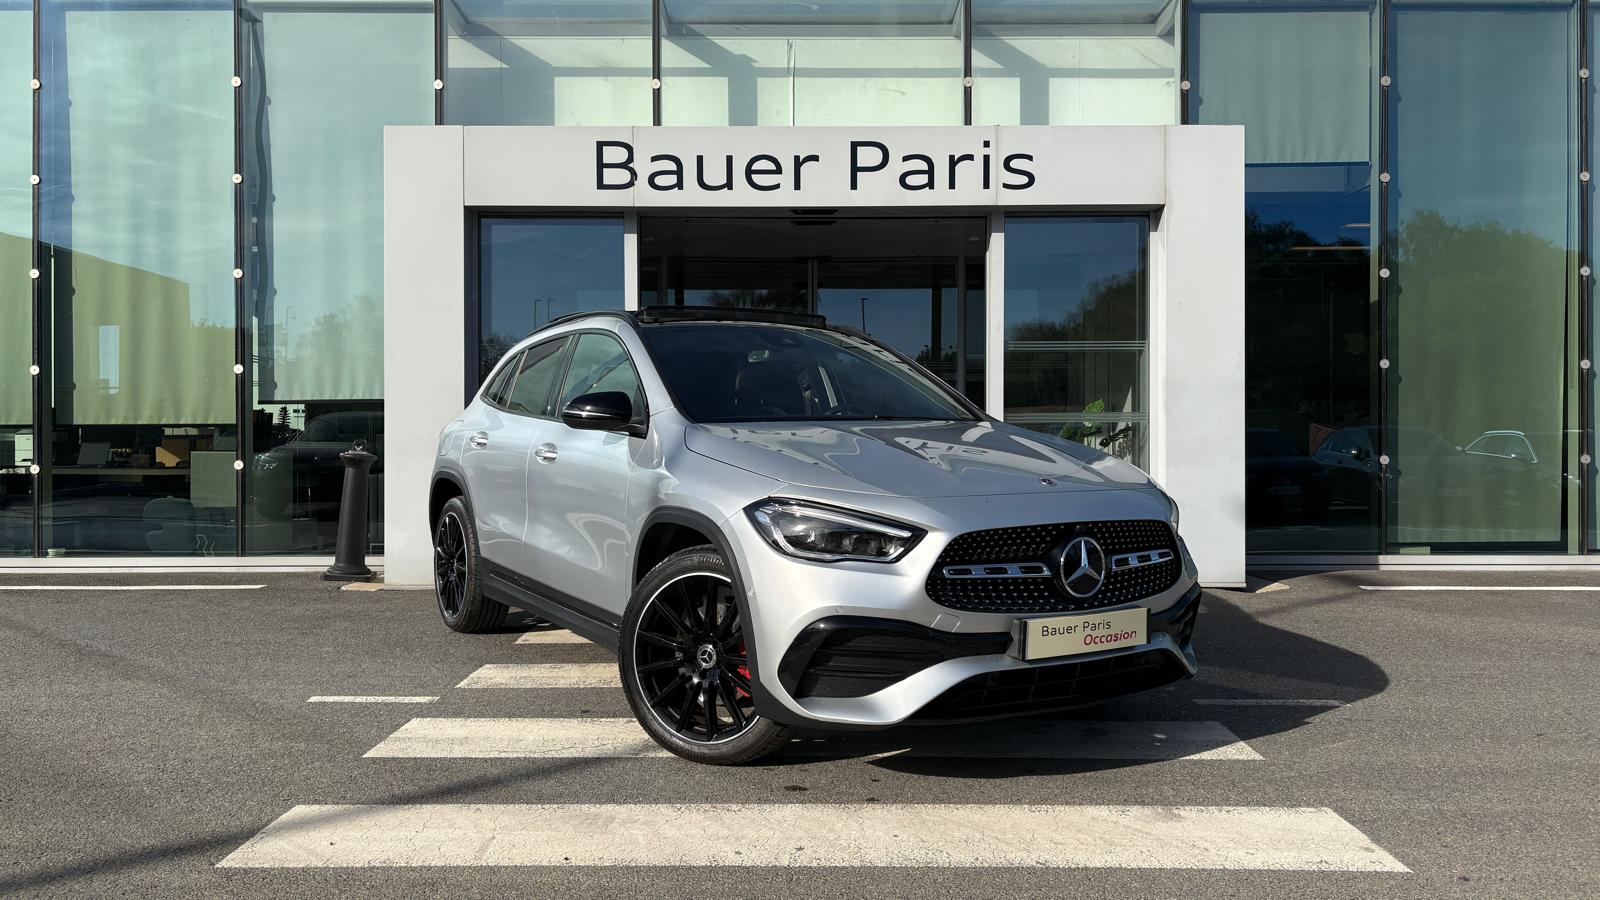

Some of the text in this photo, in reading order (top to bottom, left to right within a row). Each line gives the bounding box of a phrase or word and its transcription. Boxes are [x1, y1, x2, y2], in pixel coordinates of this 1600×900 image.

[595, 140, 1036, 191] Bauer Paris
[1041, 619, 1112, 637] Bauer Paris
[1083, 630, 1137, 646] Occasion
